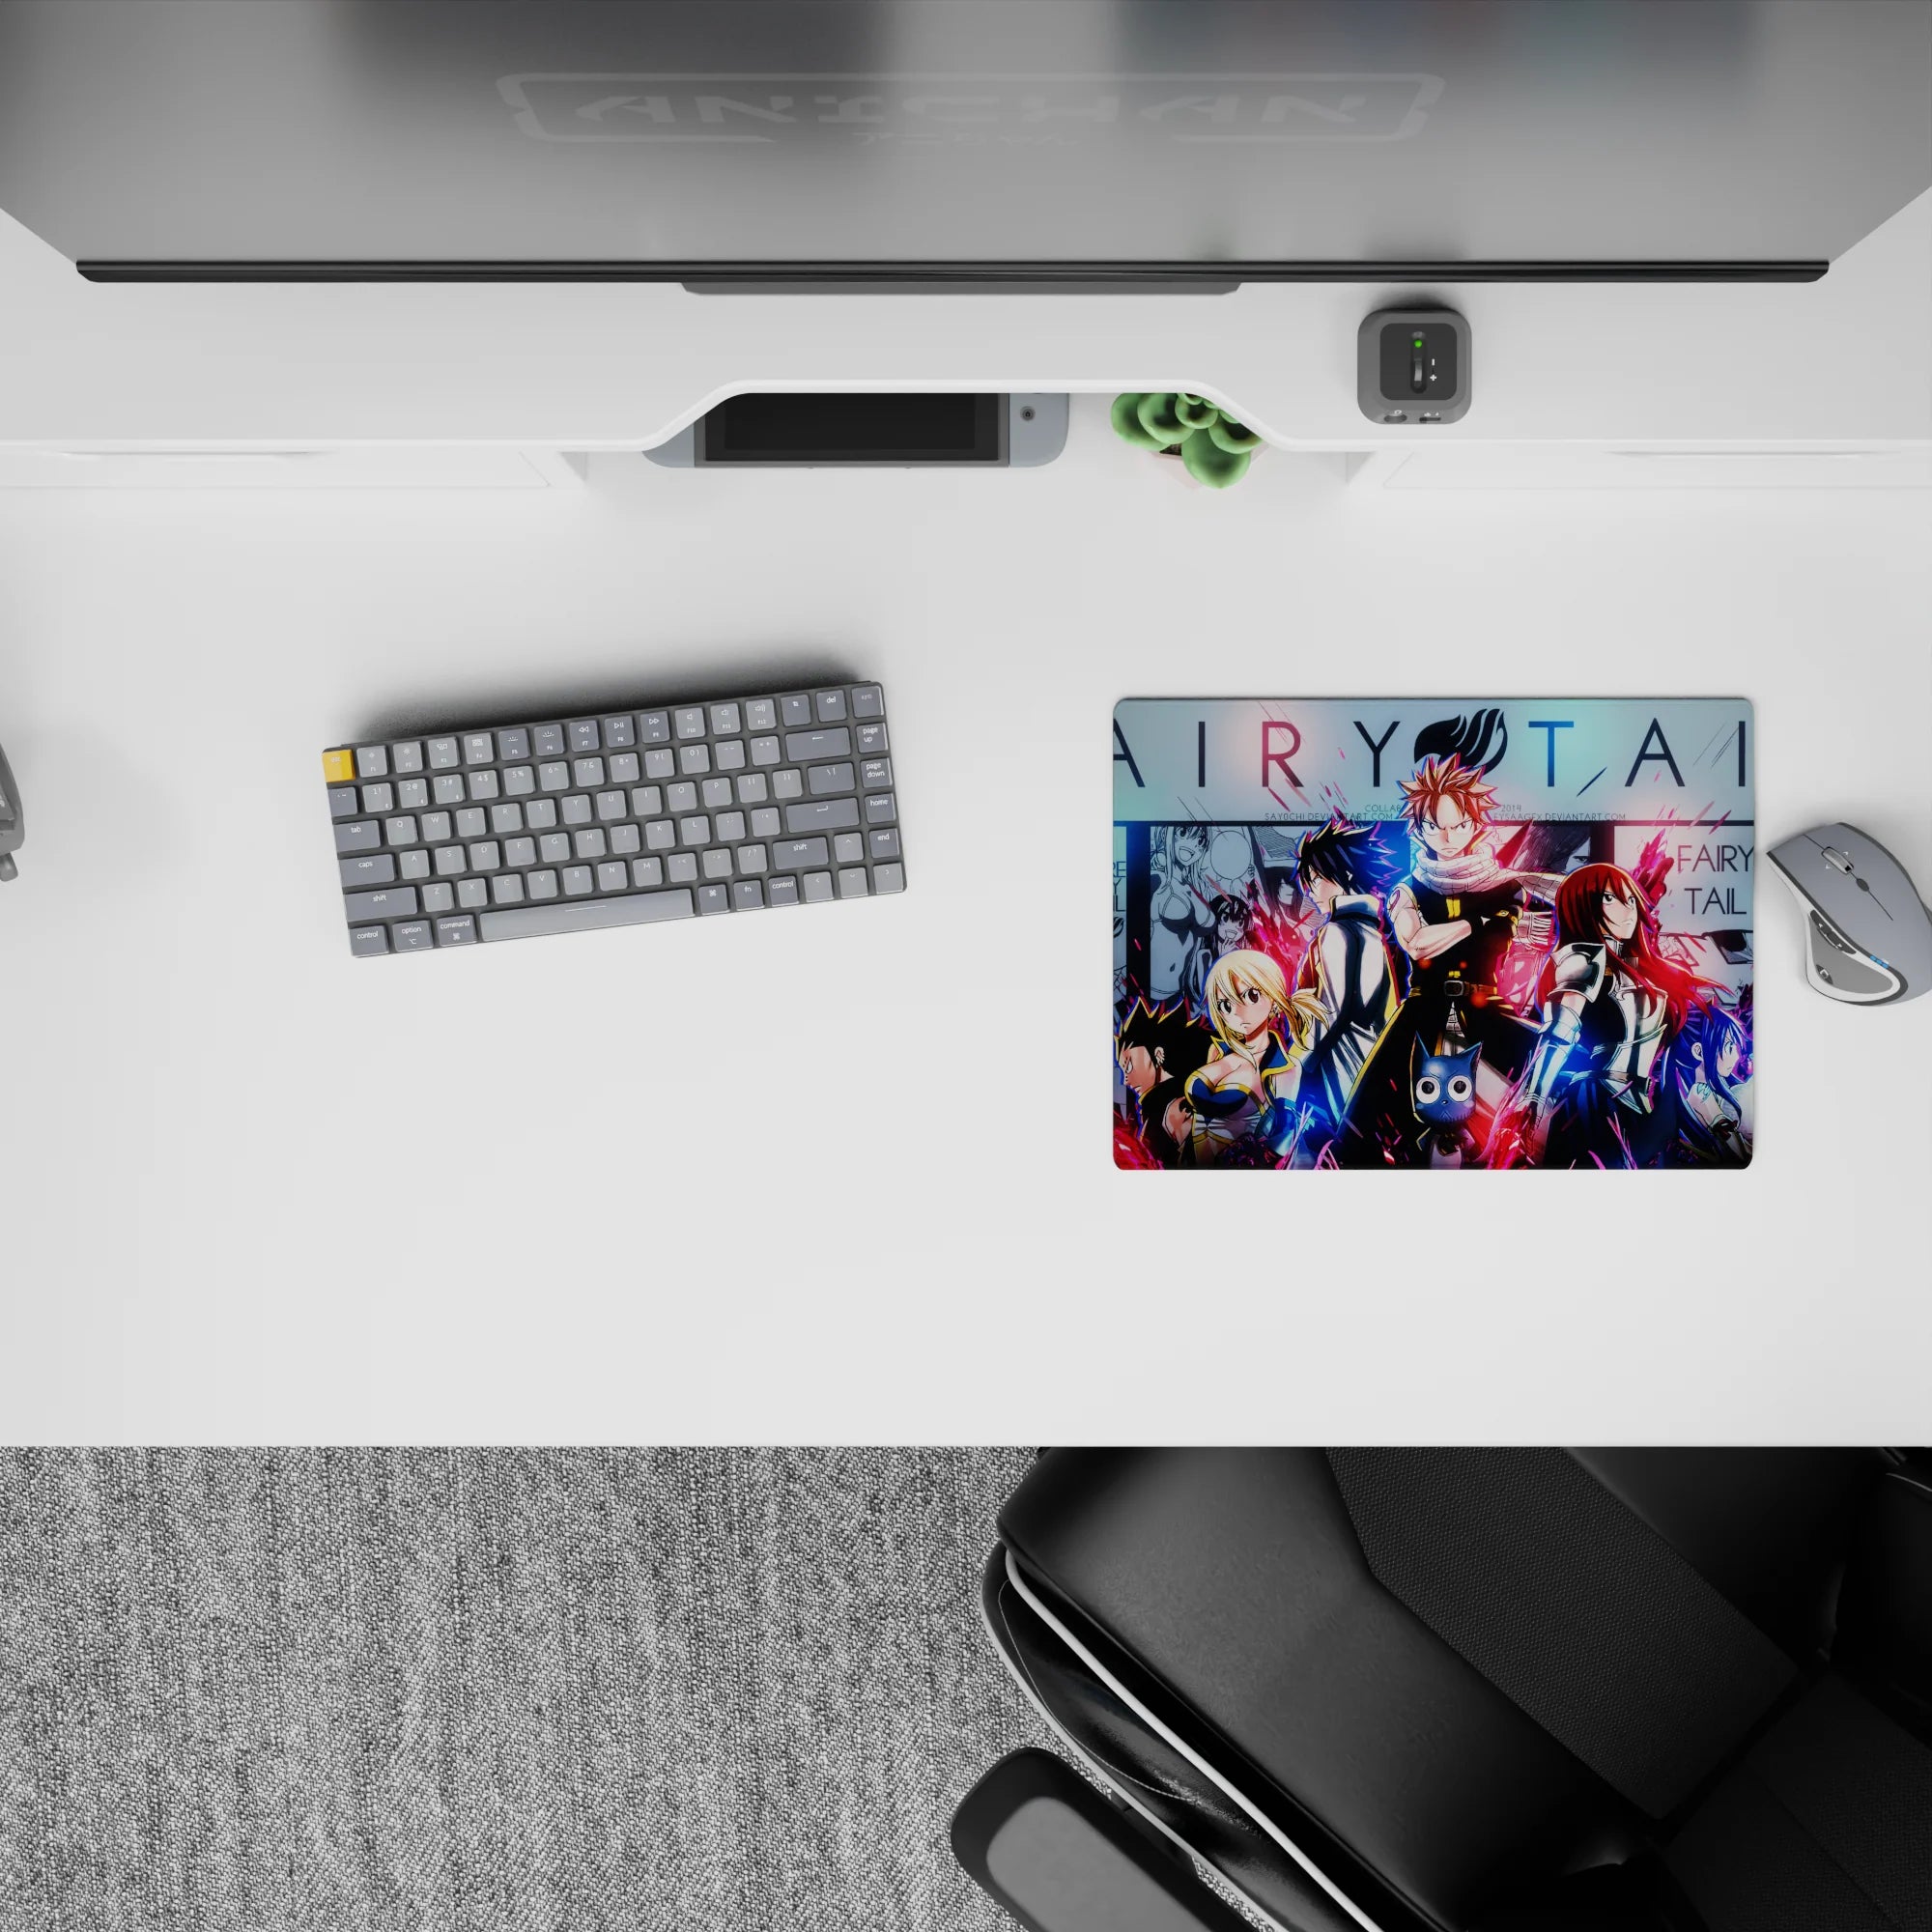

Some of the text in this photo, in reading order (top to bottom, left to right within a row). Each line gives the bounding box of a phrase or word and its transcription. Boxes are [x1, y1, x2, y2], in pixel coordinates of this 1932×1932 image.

[576, 95, 1366, 124] ANICHAN
[864, 735, 873, 744] up
[866, 762, 882, 771] page
[867, 770, 886, 779] down
[869, 798, 889, 807] home
[372, 894, 387, 902] shift
[793, 842, 808, 852] shift
[877, 833, 890, 841] end
[1677, 844, 1754, 872] FAIRY
[356, 930, 379, 939] control
[401, 925, 422, 935] option
[440, 919, 470, 929] command
[772, 880, 794, 890] control
[1684, 887, 1747, 915] TAIL
